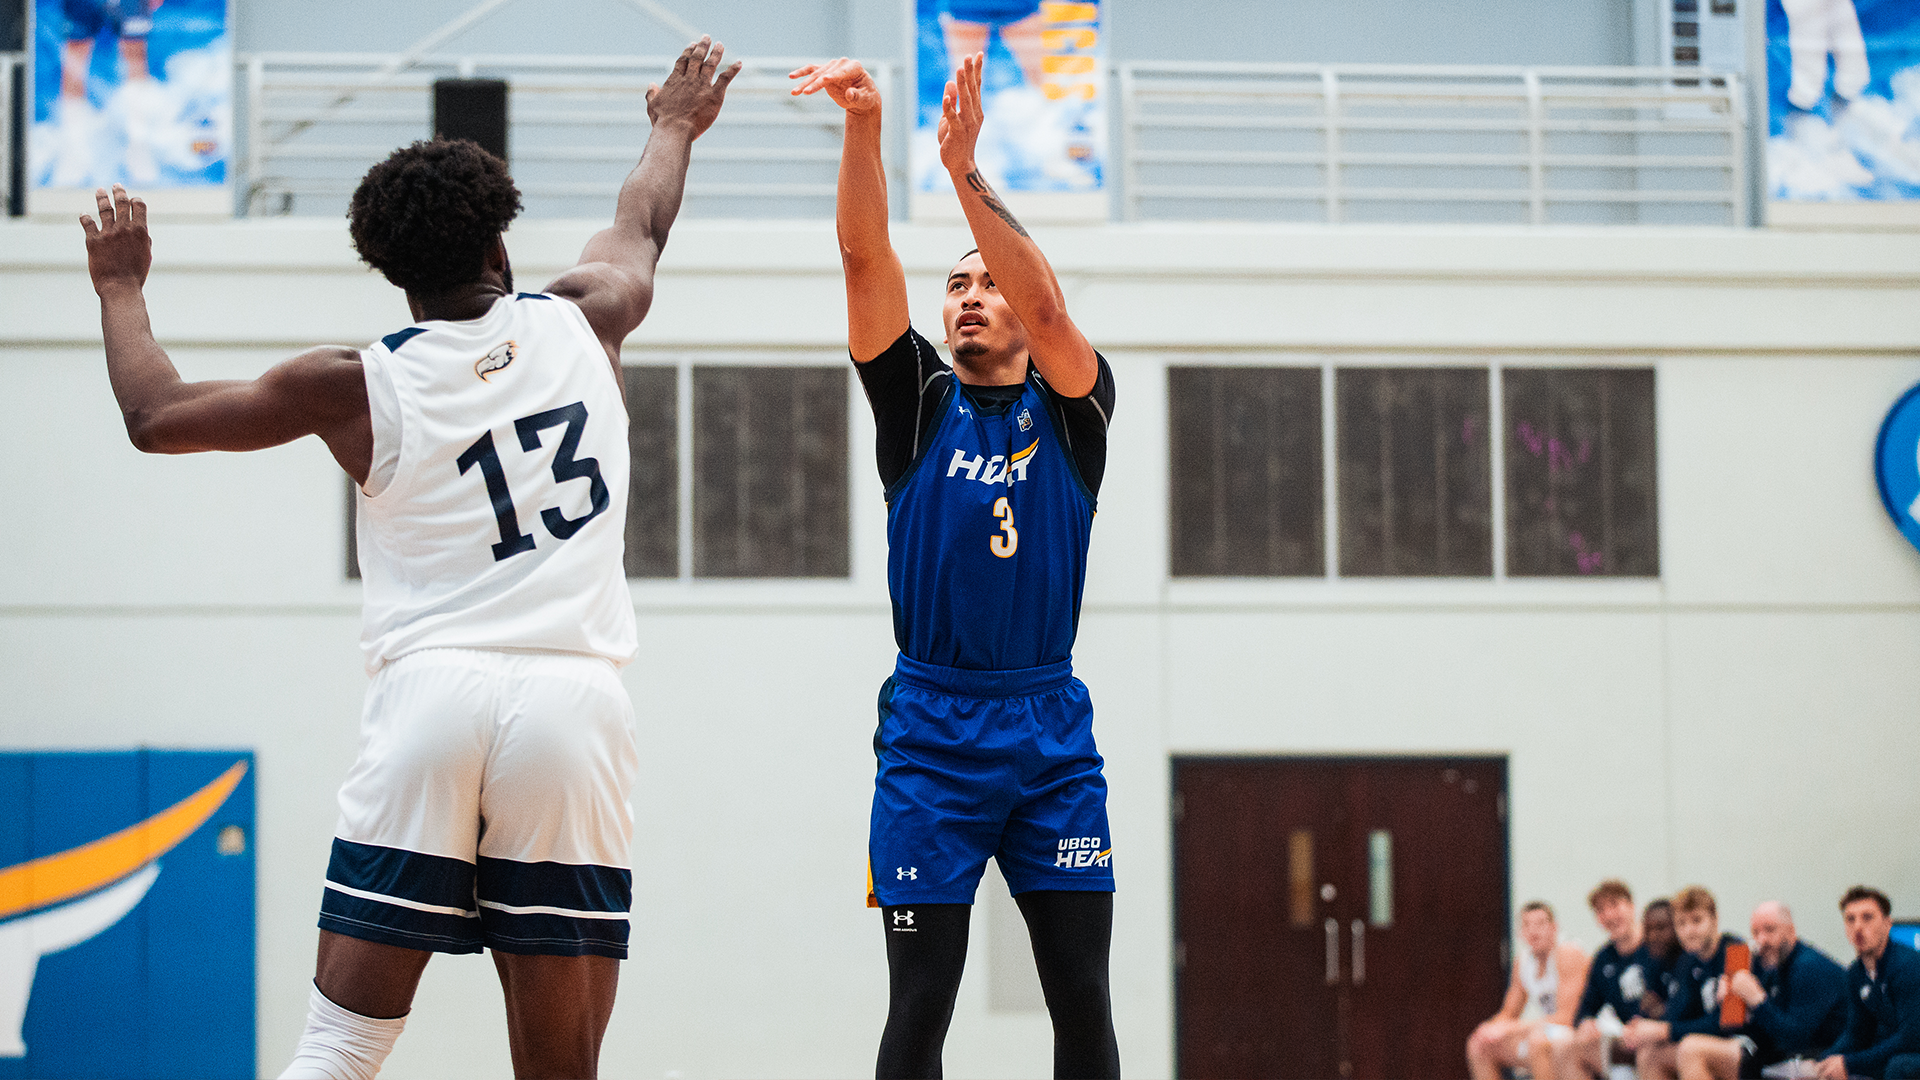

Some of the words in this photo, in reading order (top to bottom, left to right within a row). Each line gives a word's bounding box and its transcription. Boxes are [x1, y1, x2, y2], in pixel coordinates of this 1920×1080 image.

[456, 400, 610, 562] 13
[990, 496, 1018, 558] 3
[1053, 847, 1112, 869] HEAT
[1057, 836, 1101, 851] UBCO
